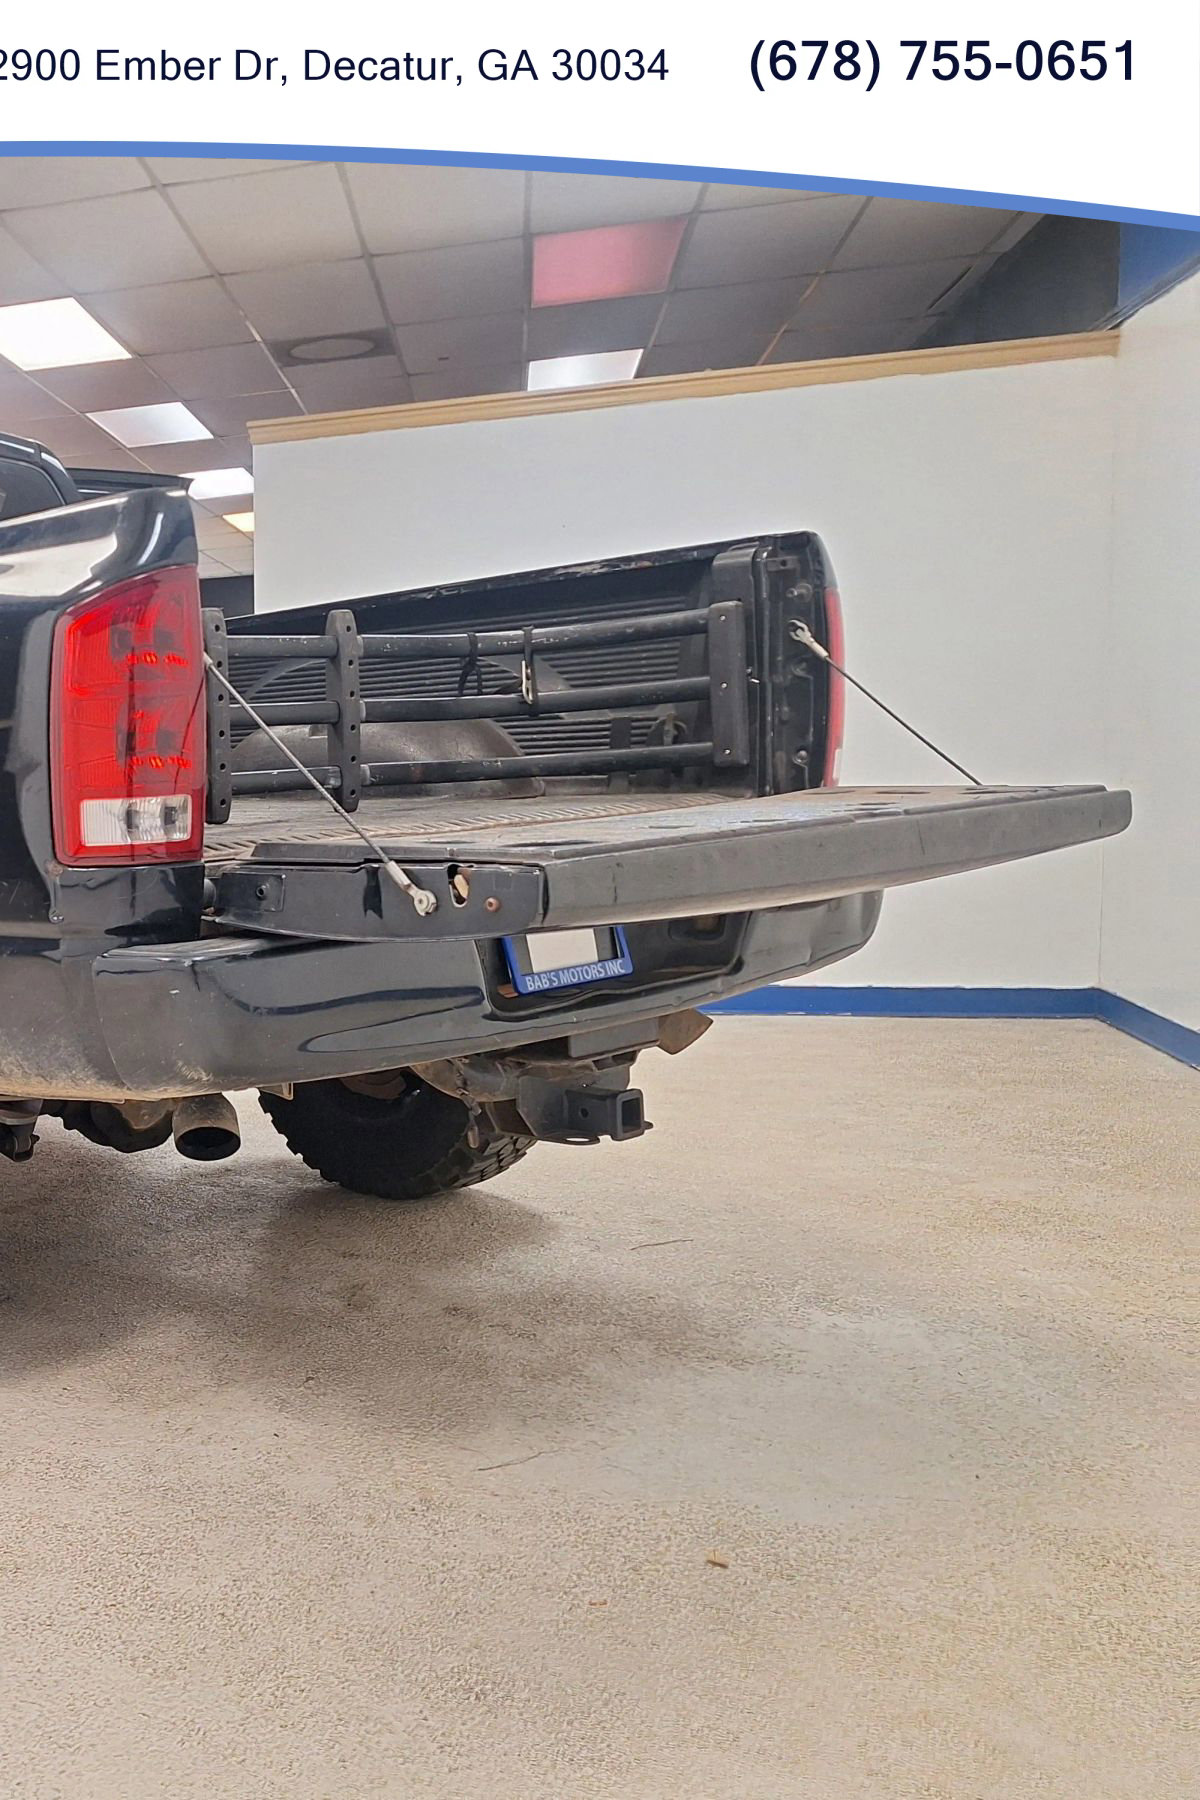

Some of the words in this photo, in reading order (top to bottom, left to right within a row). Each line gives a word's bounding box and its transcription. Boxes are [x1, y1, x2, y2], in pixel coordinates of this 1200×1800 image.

[525, 972, 559, 991] BAB'S
[559, 964, 604, 985] MOTORS
[604, 959, 626, 975] INC
